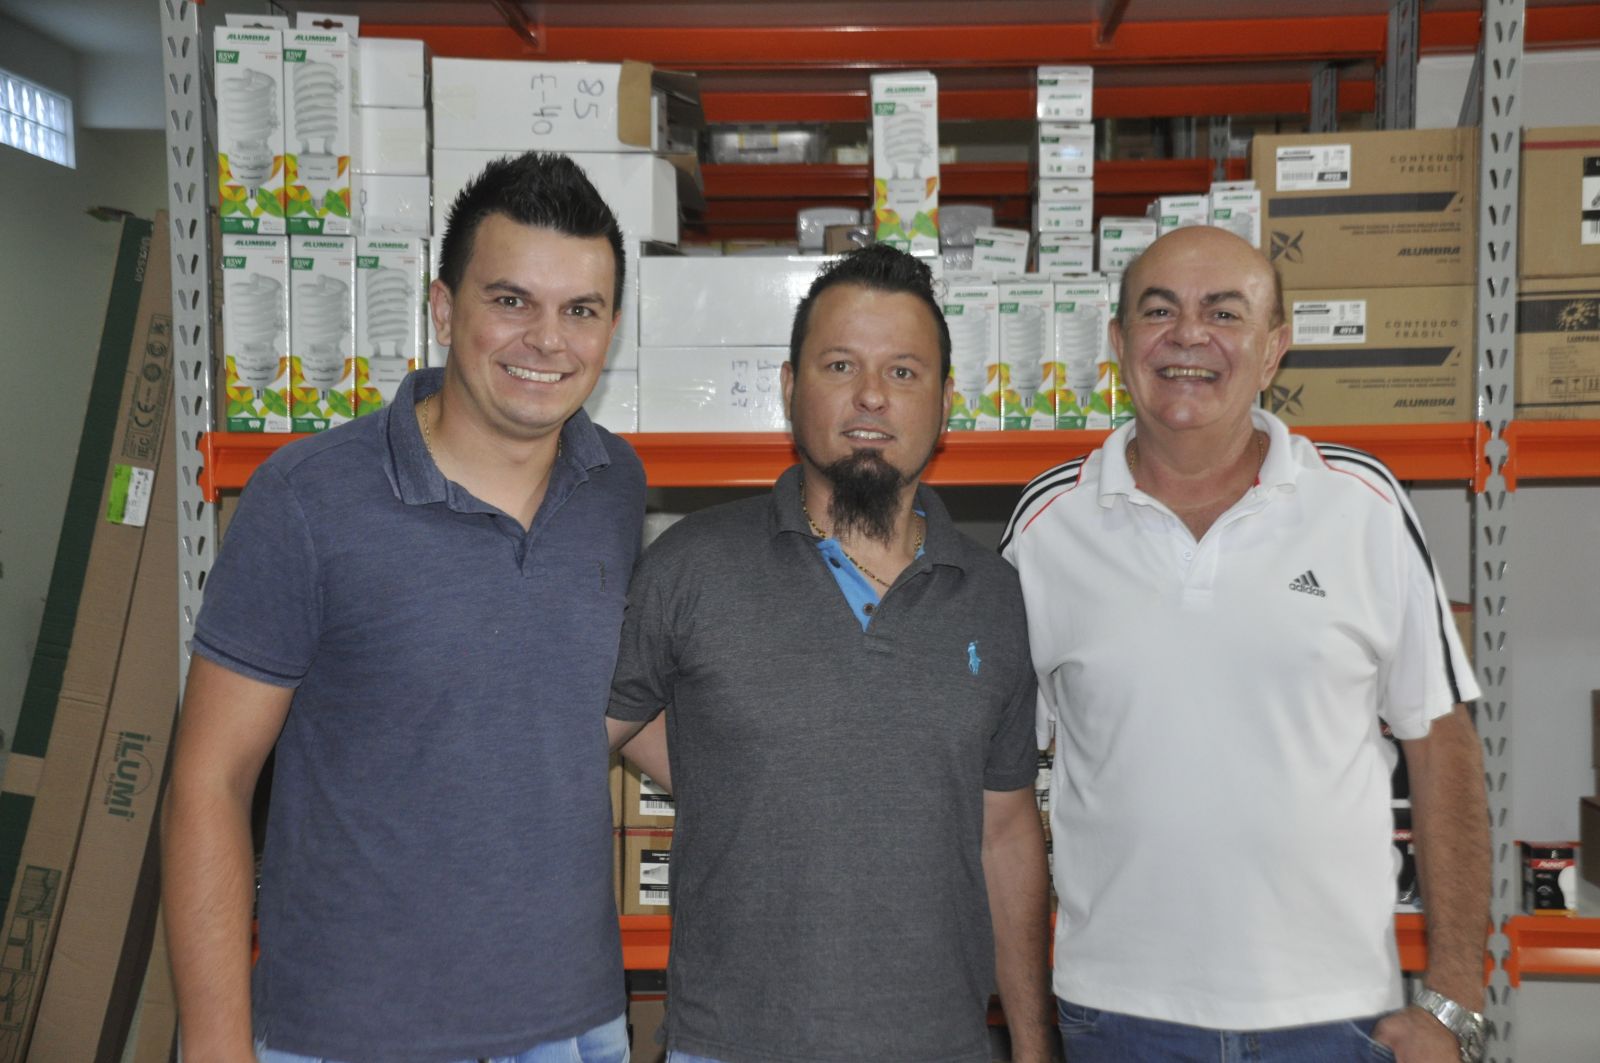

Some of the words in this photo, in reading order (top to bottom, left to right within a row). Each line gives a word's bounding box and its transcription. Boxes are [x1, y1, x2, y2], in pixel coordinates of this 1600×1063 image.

[227, 33, 270, 42] ALUMBRA
[294, 33, 337, 43] ALUMBRA
[531, 73, 562, 135] E-40
[573, 79, 605, 119] 85
[233, 239, 277, 247] ALUMBRA
[302, 241, 345, 249] ALUMBRA
[1397, 246, 1461, 257] ALUMBRA
[1393, 397, 1456, 408] ALUMBRA
[1288, 582, 1326, 598] adidas
